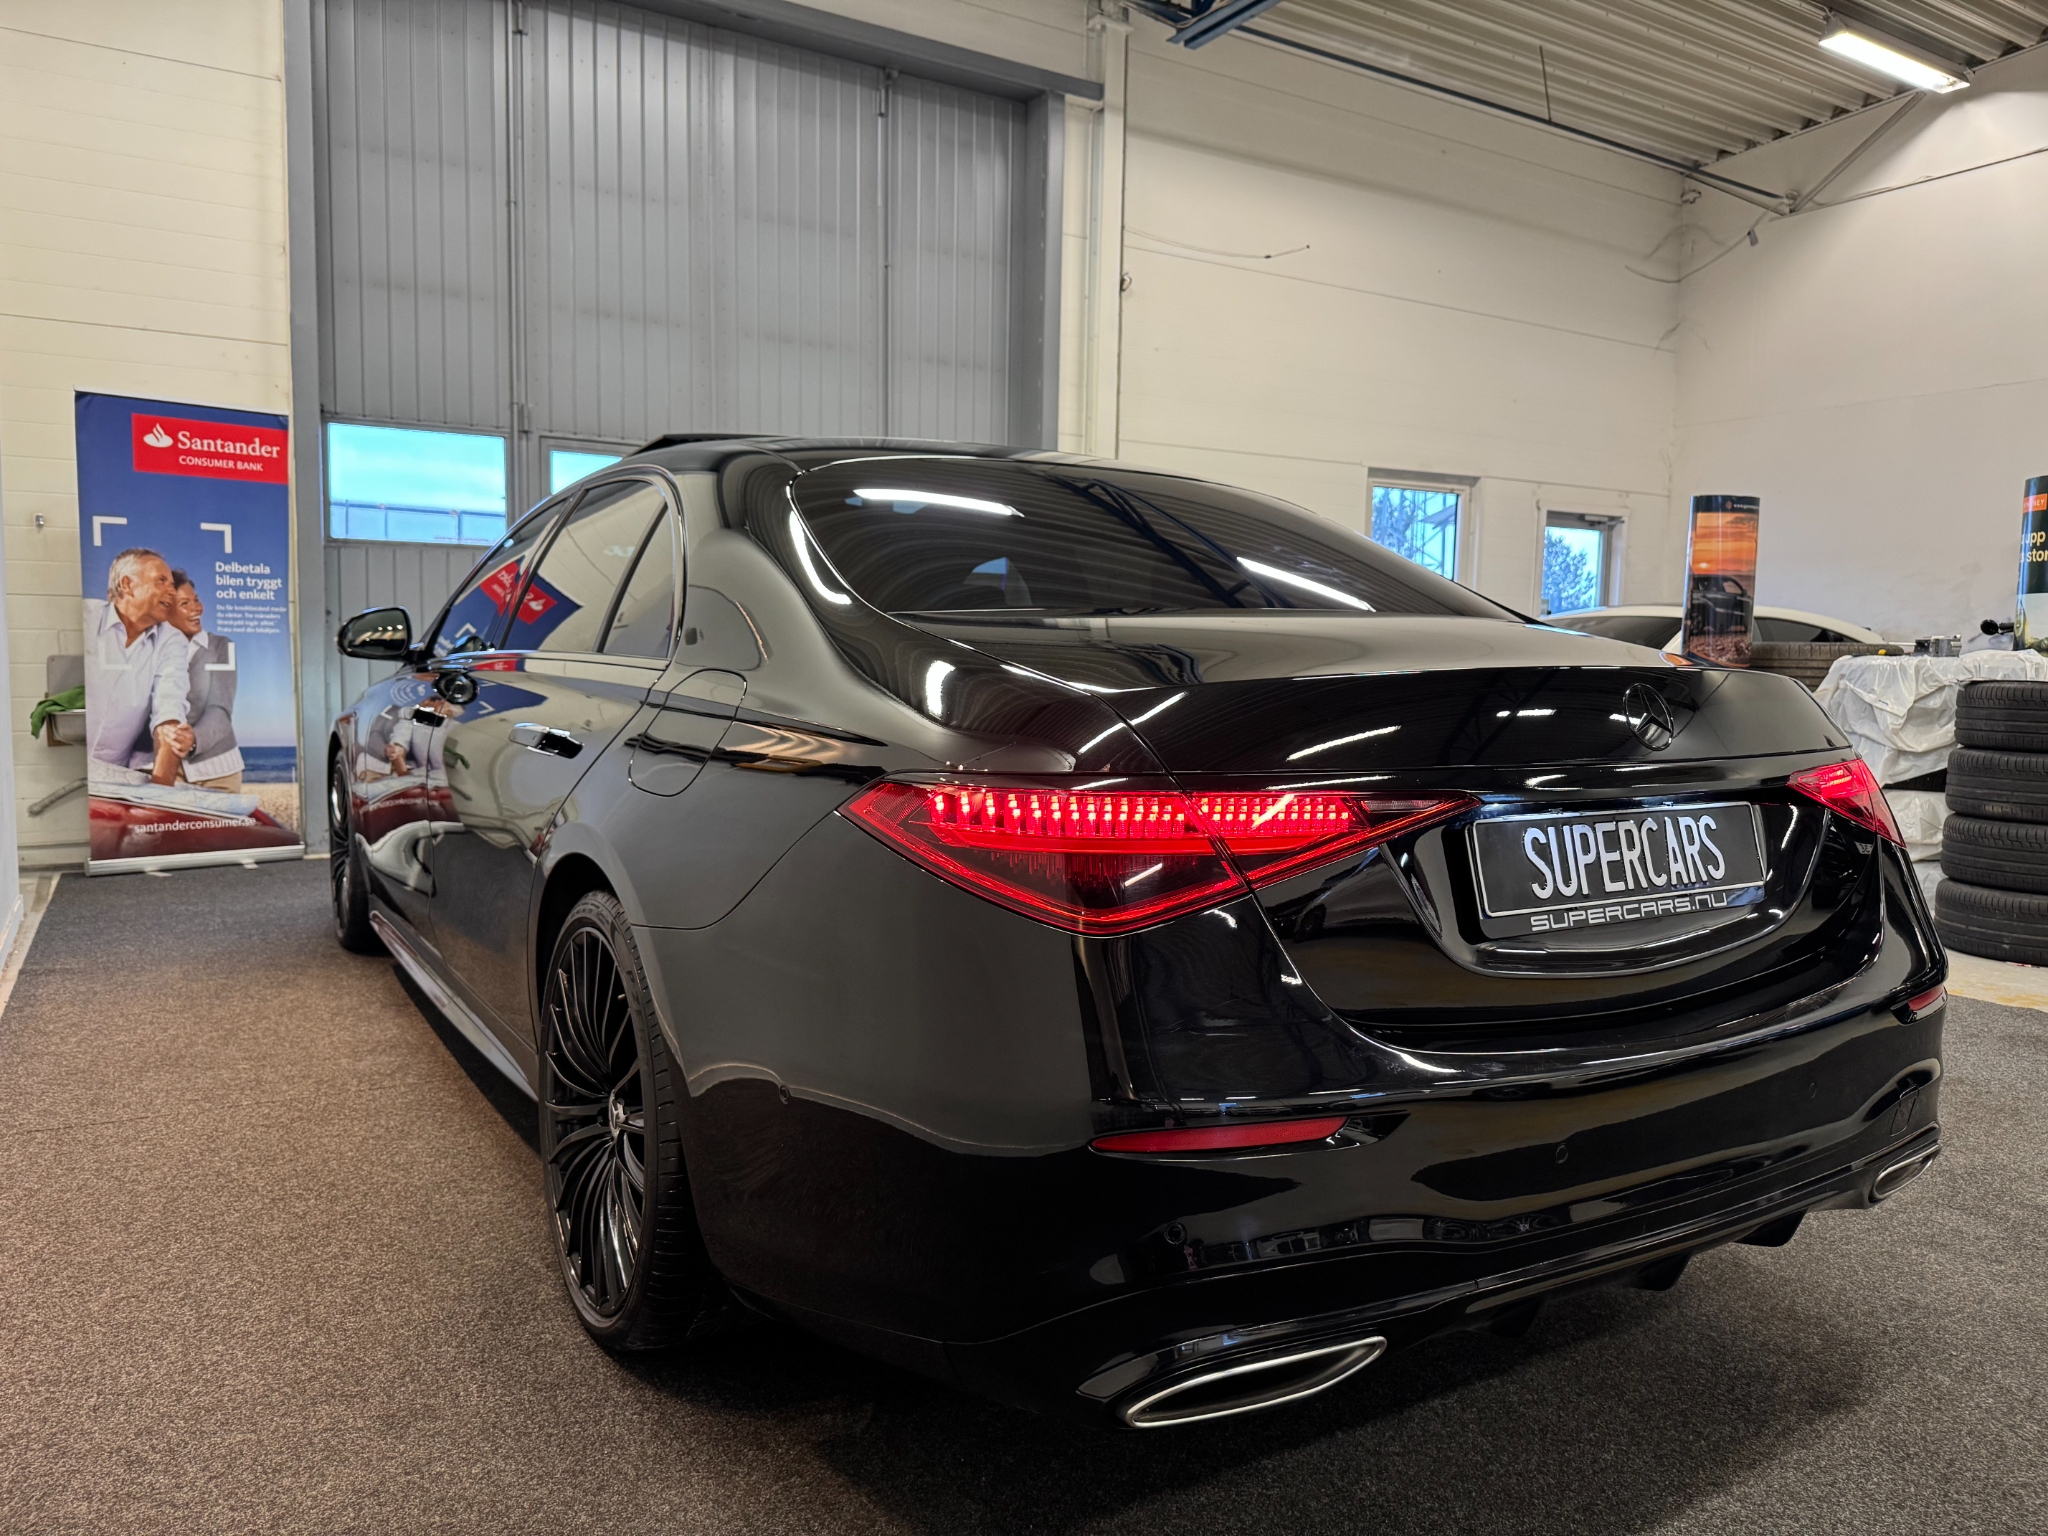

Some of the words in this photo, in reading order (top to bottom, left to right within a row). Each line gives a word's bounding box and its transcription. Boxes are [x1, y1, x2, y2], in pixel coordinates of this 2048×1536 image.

[177, 430, 280, 458] Santander
[178, 455, 235, 469] CONSUMER
[236, 461, 264, 472] BANK
[216, 561, 271, 574] Delbetala
[216, 574, 244, 586] bilen
[246, 576, 283, 590] tryggt
[216, 587, 237, 599] och
[239, 589, 275, 600] enkelt
[134, 818, 257, 833] santanderconsumer.se
[1524, 815, 1726, 900] SUPERCARS
[1530, 892, 1728, 932] SUPERCARS.NU
